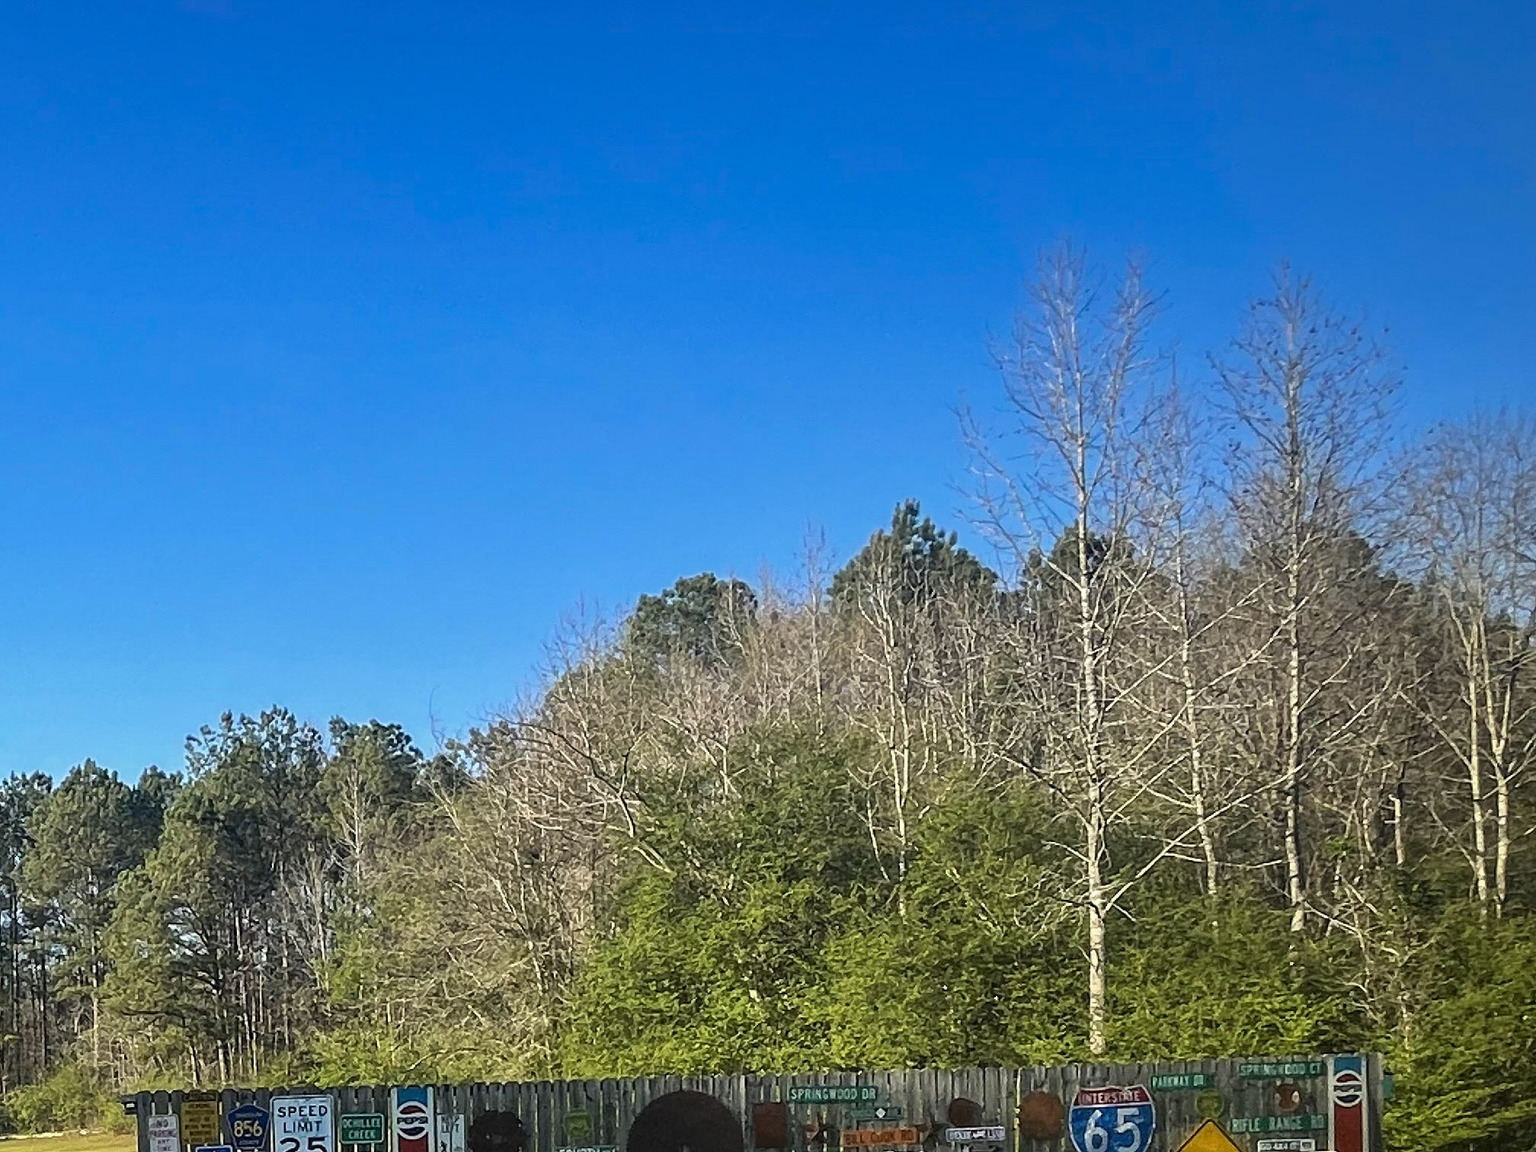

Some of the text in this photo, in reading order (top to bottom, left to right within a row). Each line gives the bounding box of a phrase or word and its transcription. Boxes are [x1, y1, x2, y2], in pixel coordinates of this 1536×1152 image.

[790, 1087, 877, 1101] SPRINGWOOD DR
[1078, 1089, 1140, 1105] INTERSTATE
[277, 1104, 328, 1118] SPEED
[233, 1120, 263, 1137] 856
[283, 1120, 323, 1134] LIMIT
[1231, 1118, 1261, 1133] RIFLE
[1268, 1116, 1303, 1131] RANGE
[348, 1130, 375, 1139] CREEK
